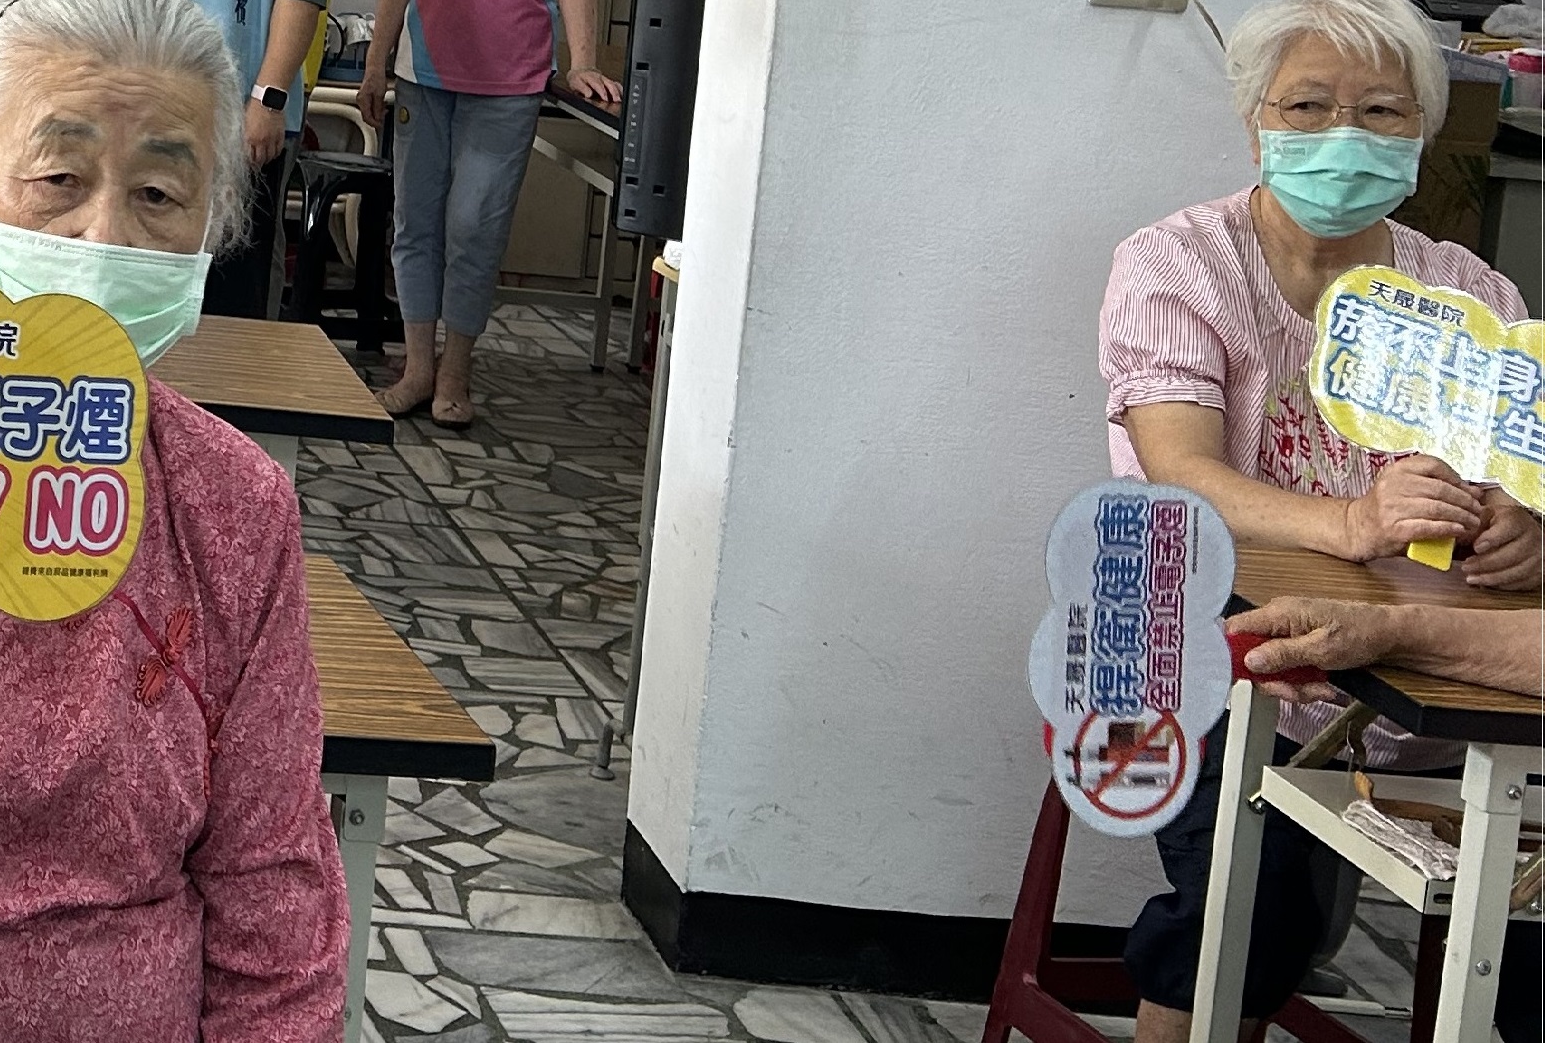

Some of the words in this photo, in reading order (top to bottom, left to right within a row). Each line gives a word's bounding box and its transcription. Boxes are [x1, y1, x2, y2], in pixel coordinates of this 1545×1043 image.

[1368, 279, 1466, 327] 天晟醫院
[26, 467, 126, 554] NO
[1091, 494, 1148, 717] 捍衛健康
[1146, 500, 1187, 711] 全面禁止電子煙
